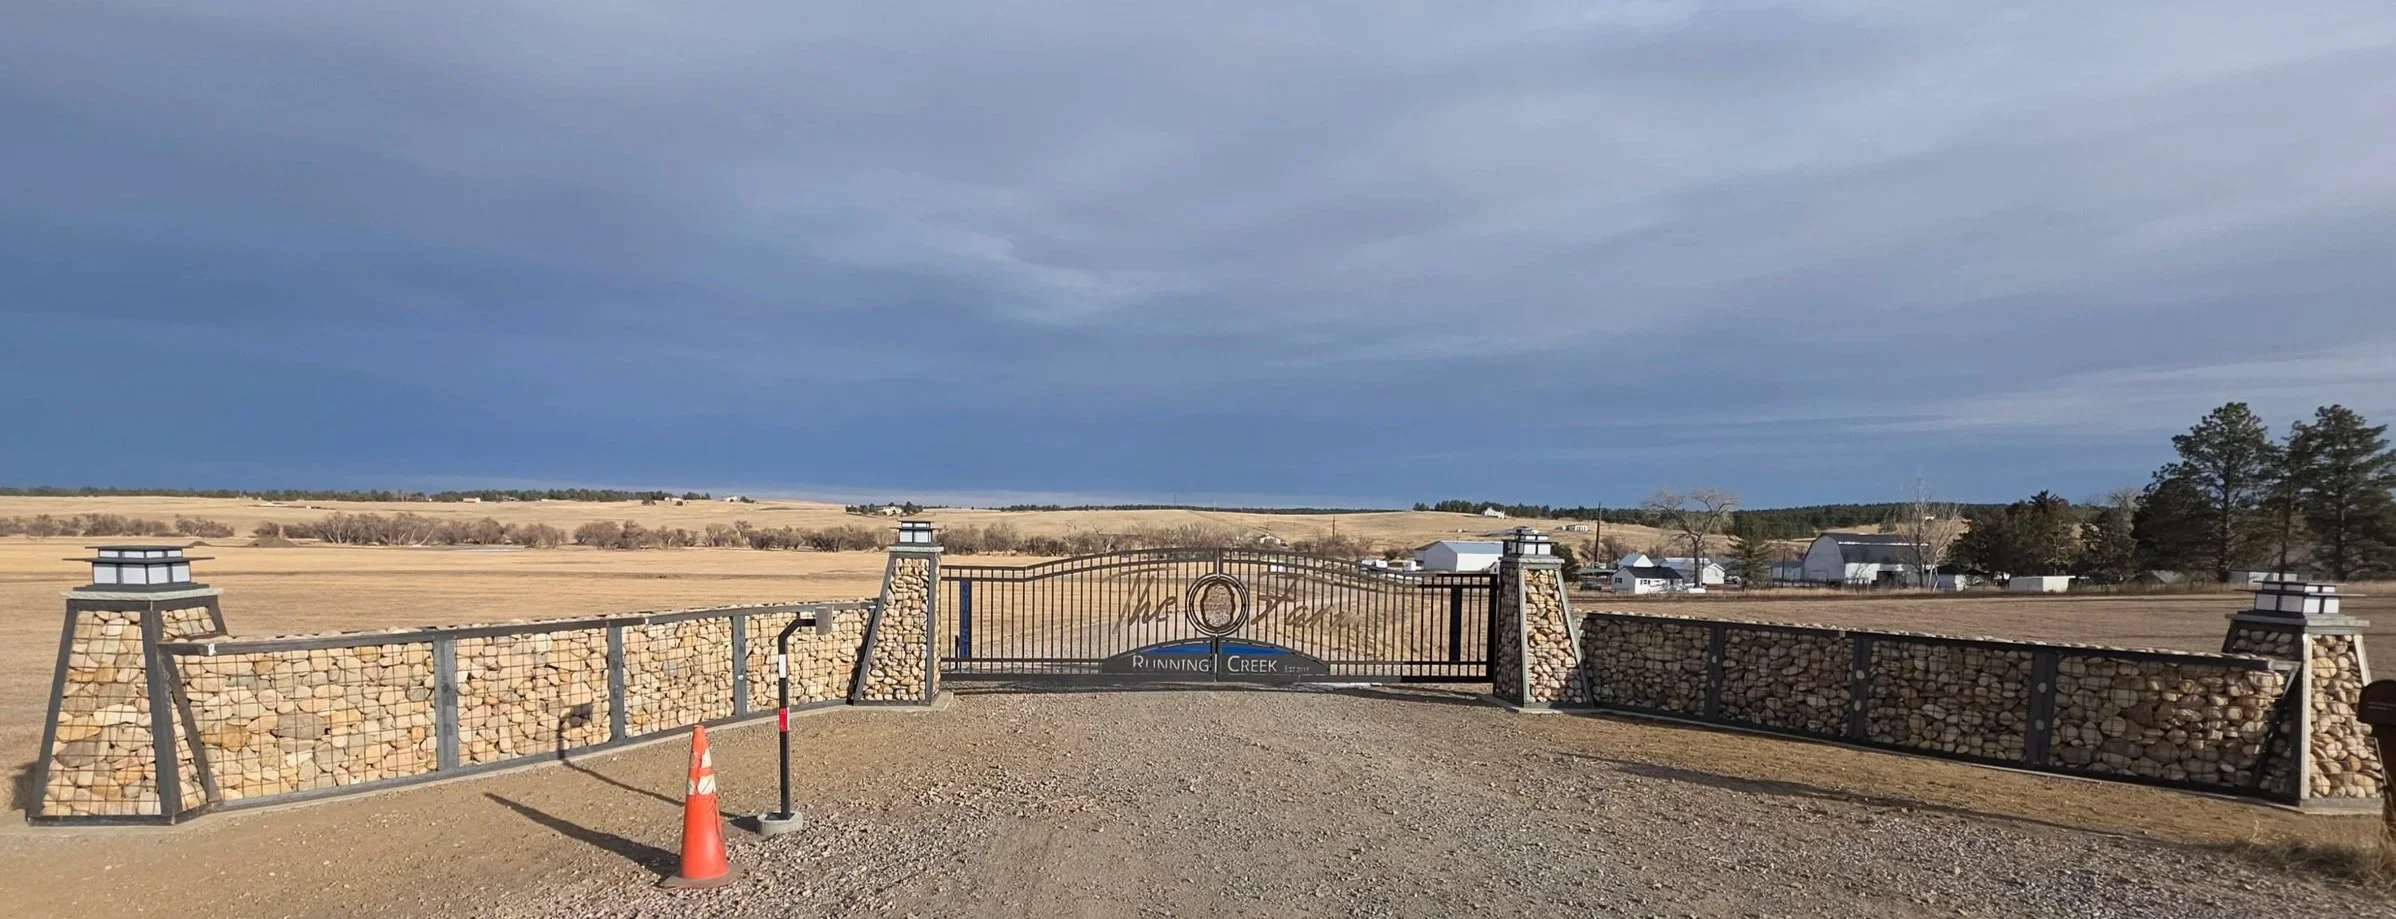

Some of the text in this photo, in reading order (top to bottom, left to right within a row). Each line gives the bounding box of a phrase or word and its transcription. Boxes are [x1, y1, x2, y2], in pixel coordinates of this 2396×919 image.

[1102, 566, 1177, 634] The
[1132, 655, 1277, 672] RUNNING CREEK
